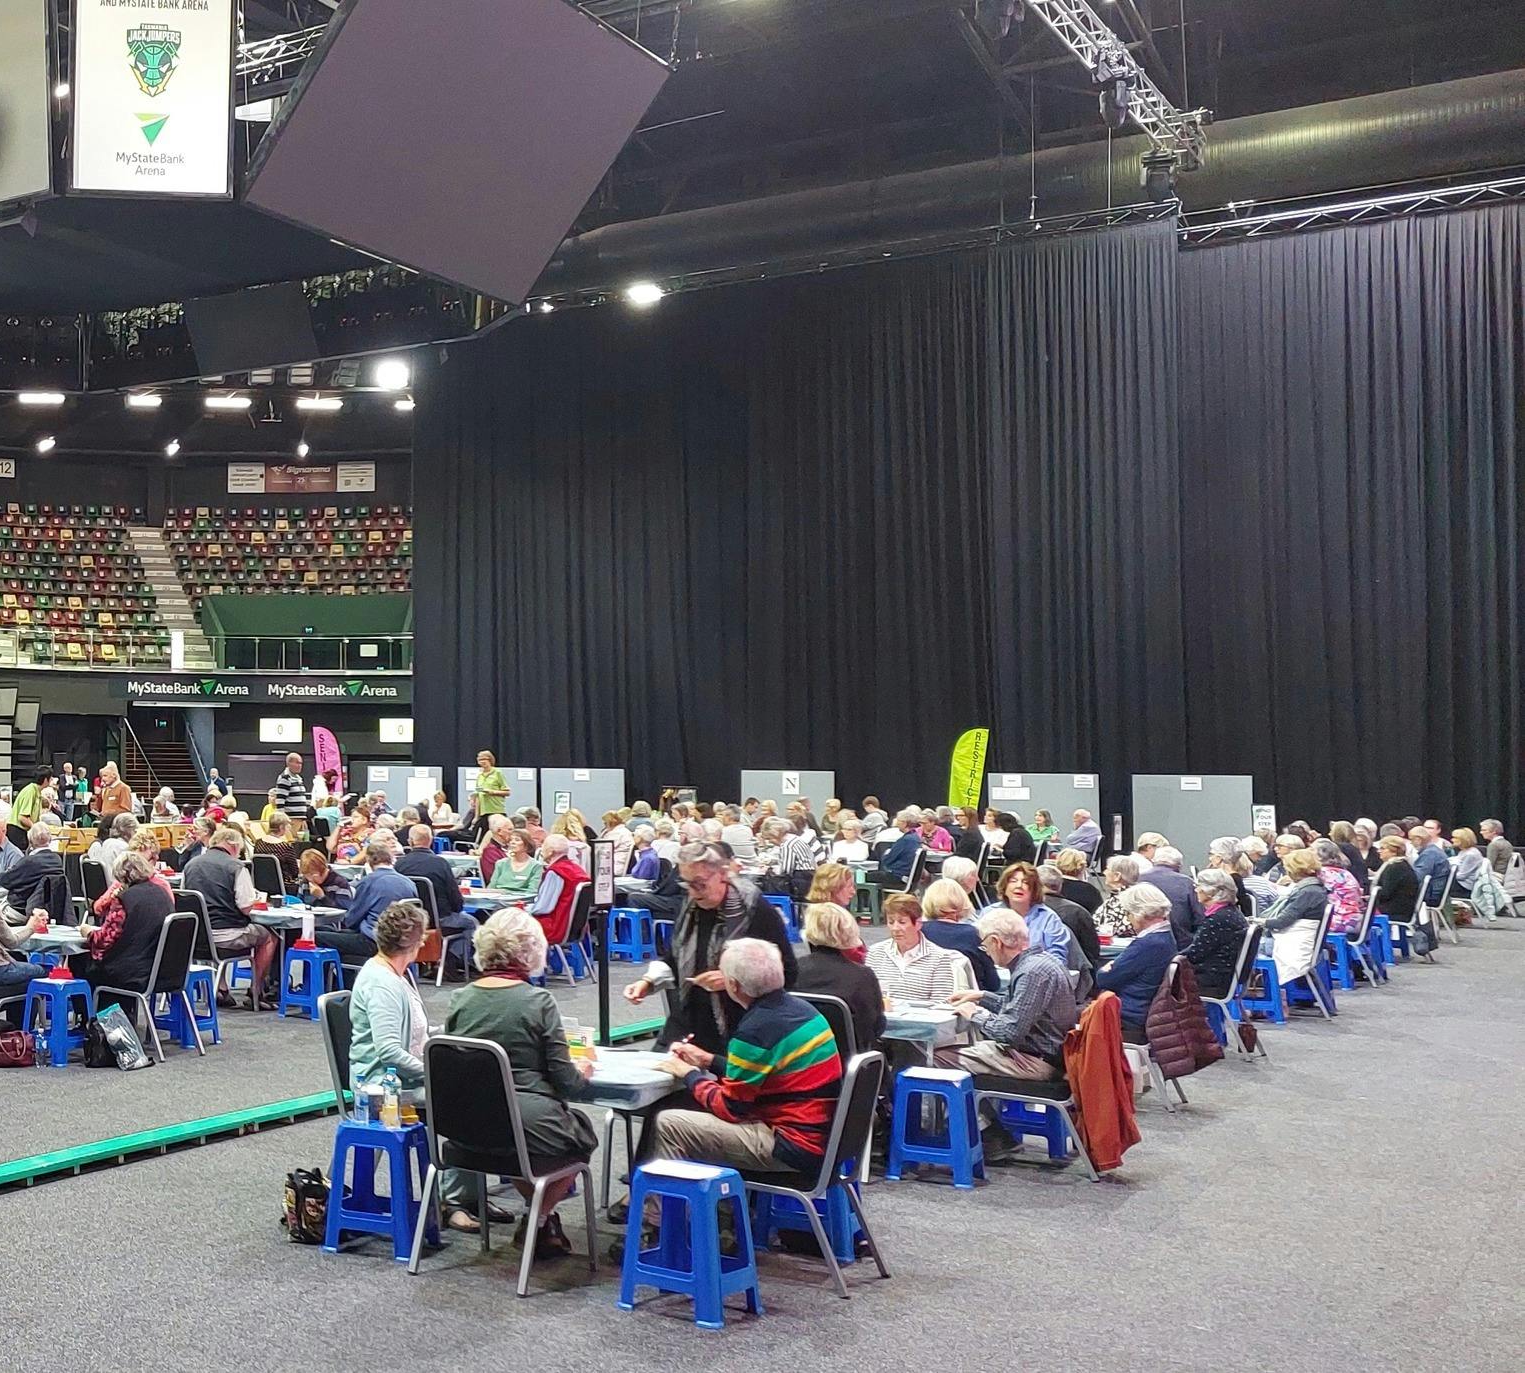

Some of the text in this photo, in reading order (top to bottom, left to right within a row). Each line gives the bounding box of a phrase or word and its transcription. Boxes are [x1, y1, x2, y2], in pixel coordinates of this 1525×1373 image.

[119, 0, 155, 8] MYSTATE
[158, 0, 180, 10] BANK
[182, 0, 209, 11] ARENA
[116, 152, 185, 165] MyStateBank
[135, 165, 166, 175] Arena
[127, 681, 249, 696] MyStateBank Arena
[268, 683, 398, 698] MyStateBank Arena
[785, 778, 797, 789] N
